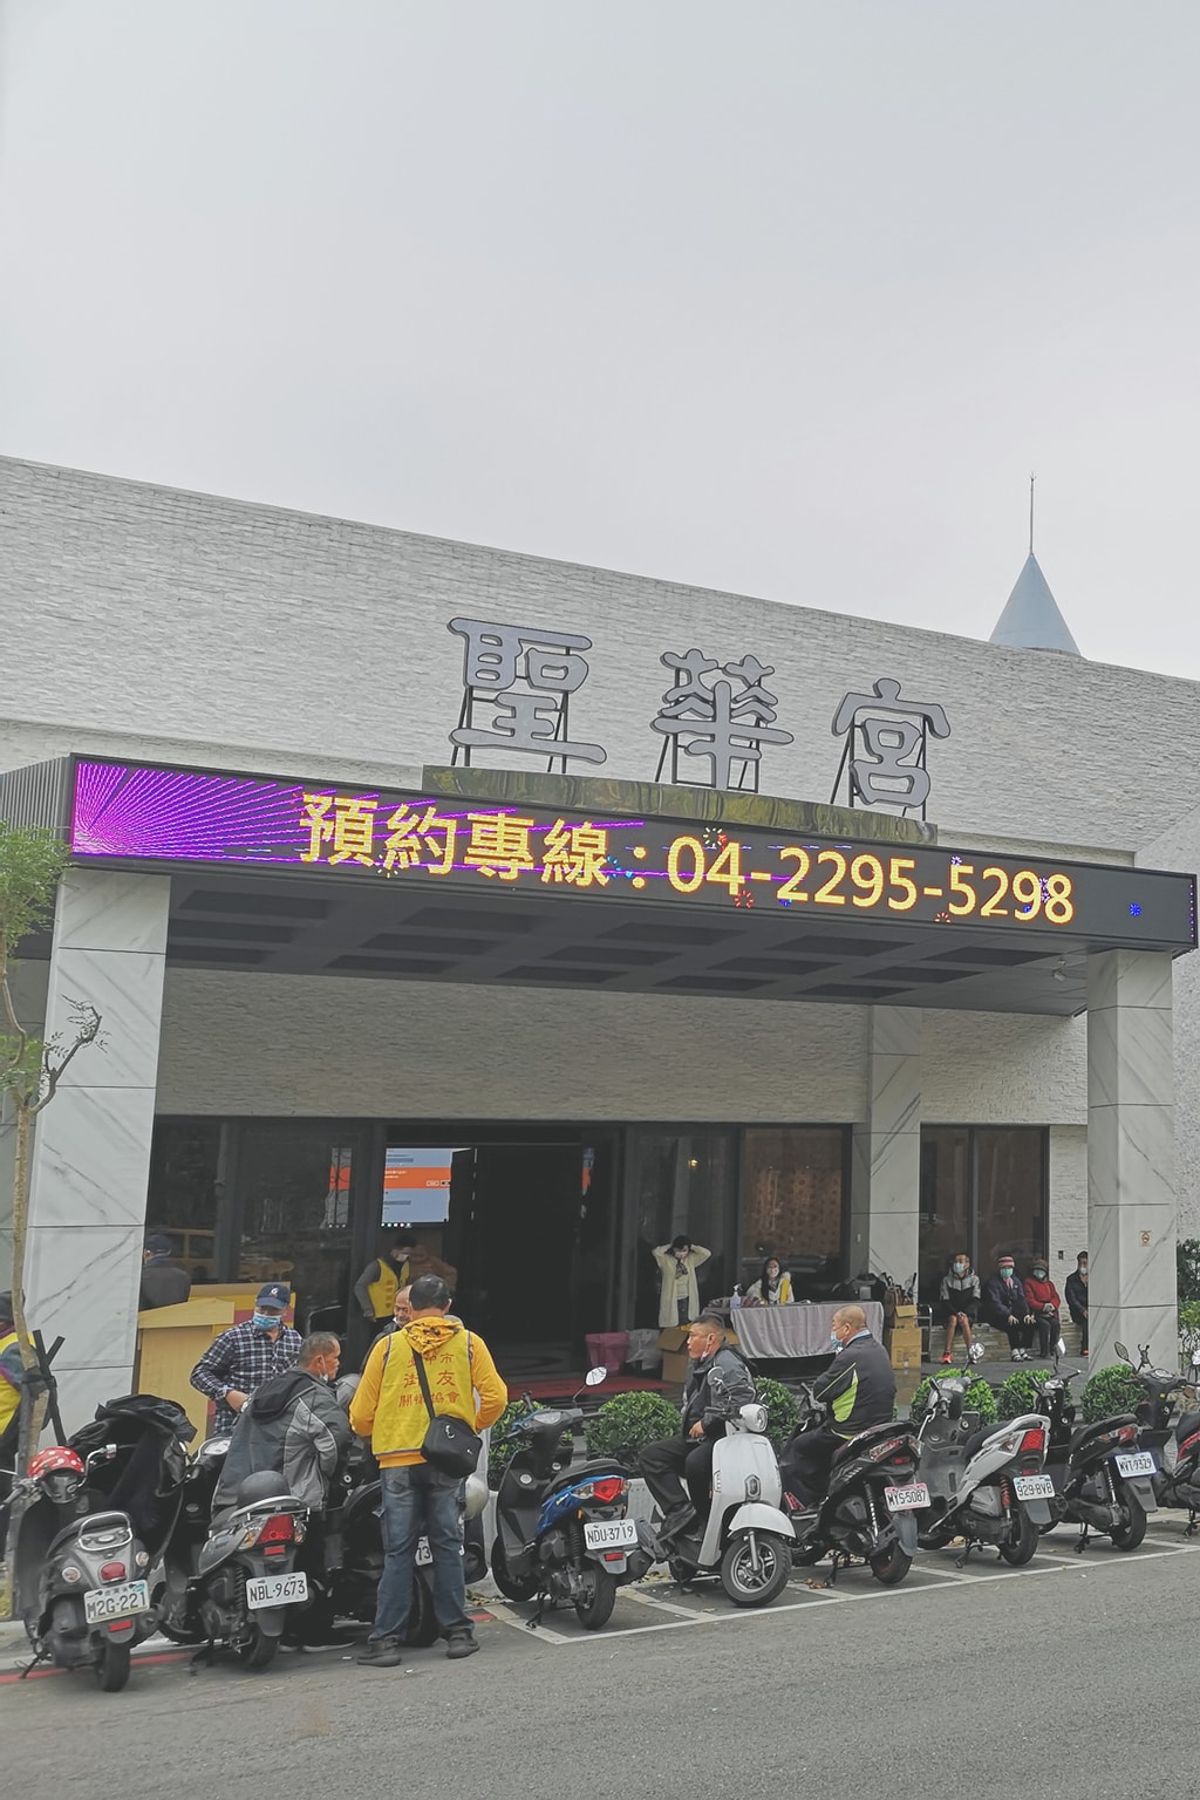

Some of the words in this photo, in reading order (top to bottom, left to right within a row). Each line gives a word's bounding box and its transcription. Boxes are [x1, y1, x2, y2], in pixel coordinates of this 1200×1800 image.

[447, 616, 951, 808] 聖華宮
[587, 1525, 634, 1545] NDU-3719
[250, 1579, 305, 1603] NBL-9673
[87, 1591, 146, 1620] M2G-221
